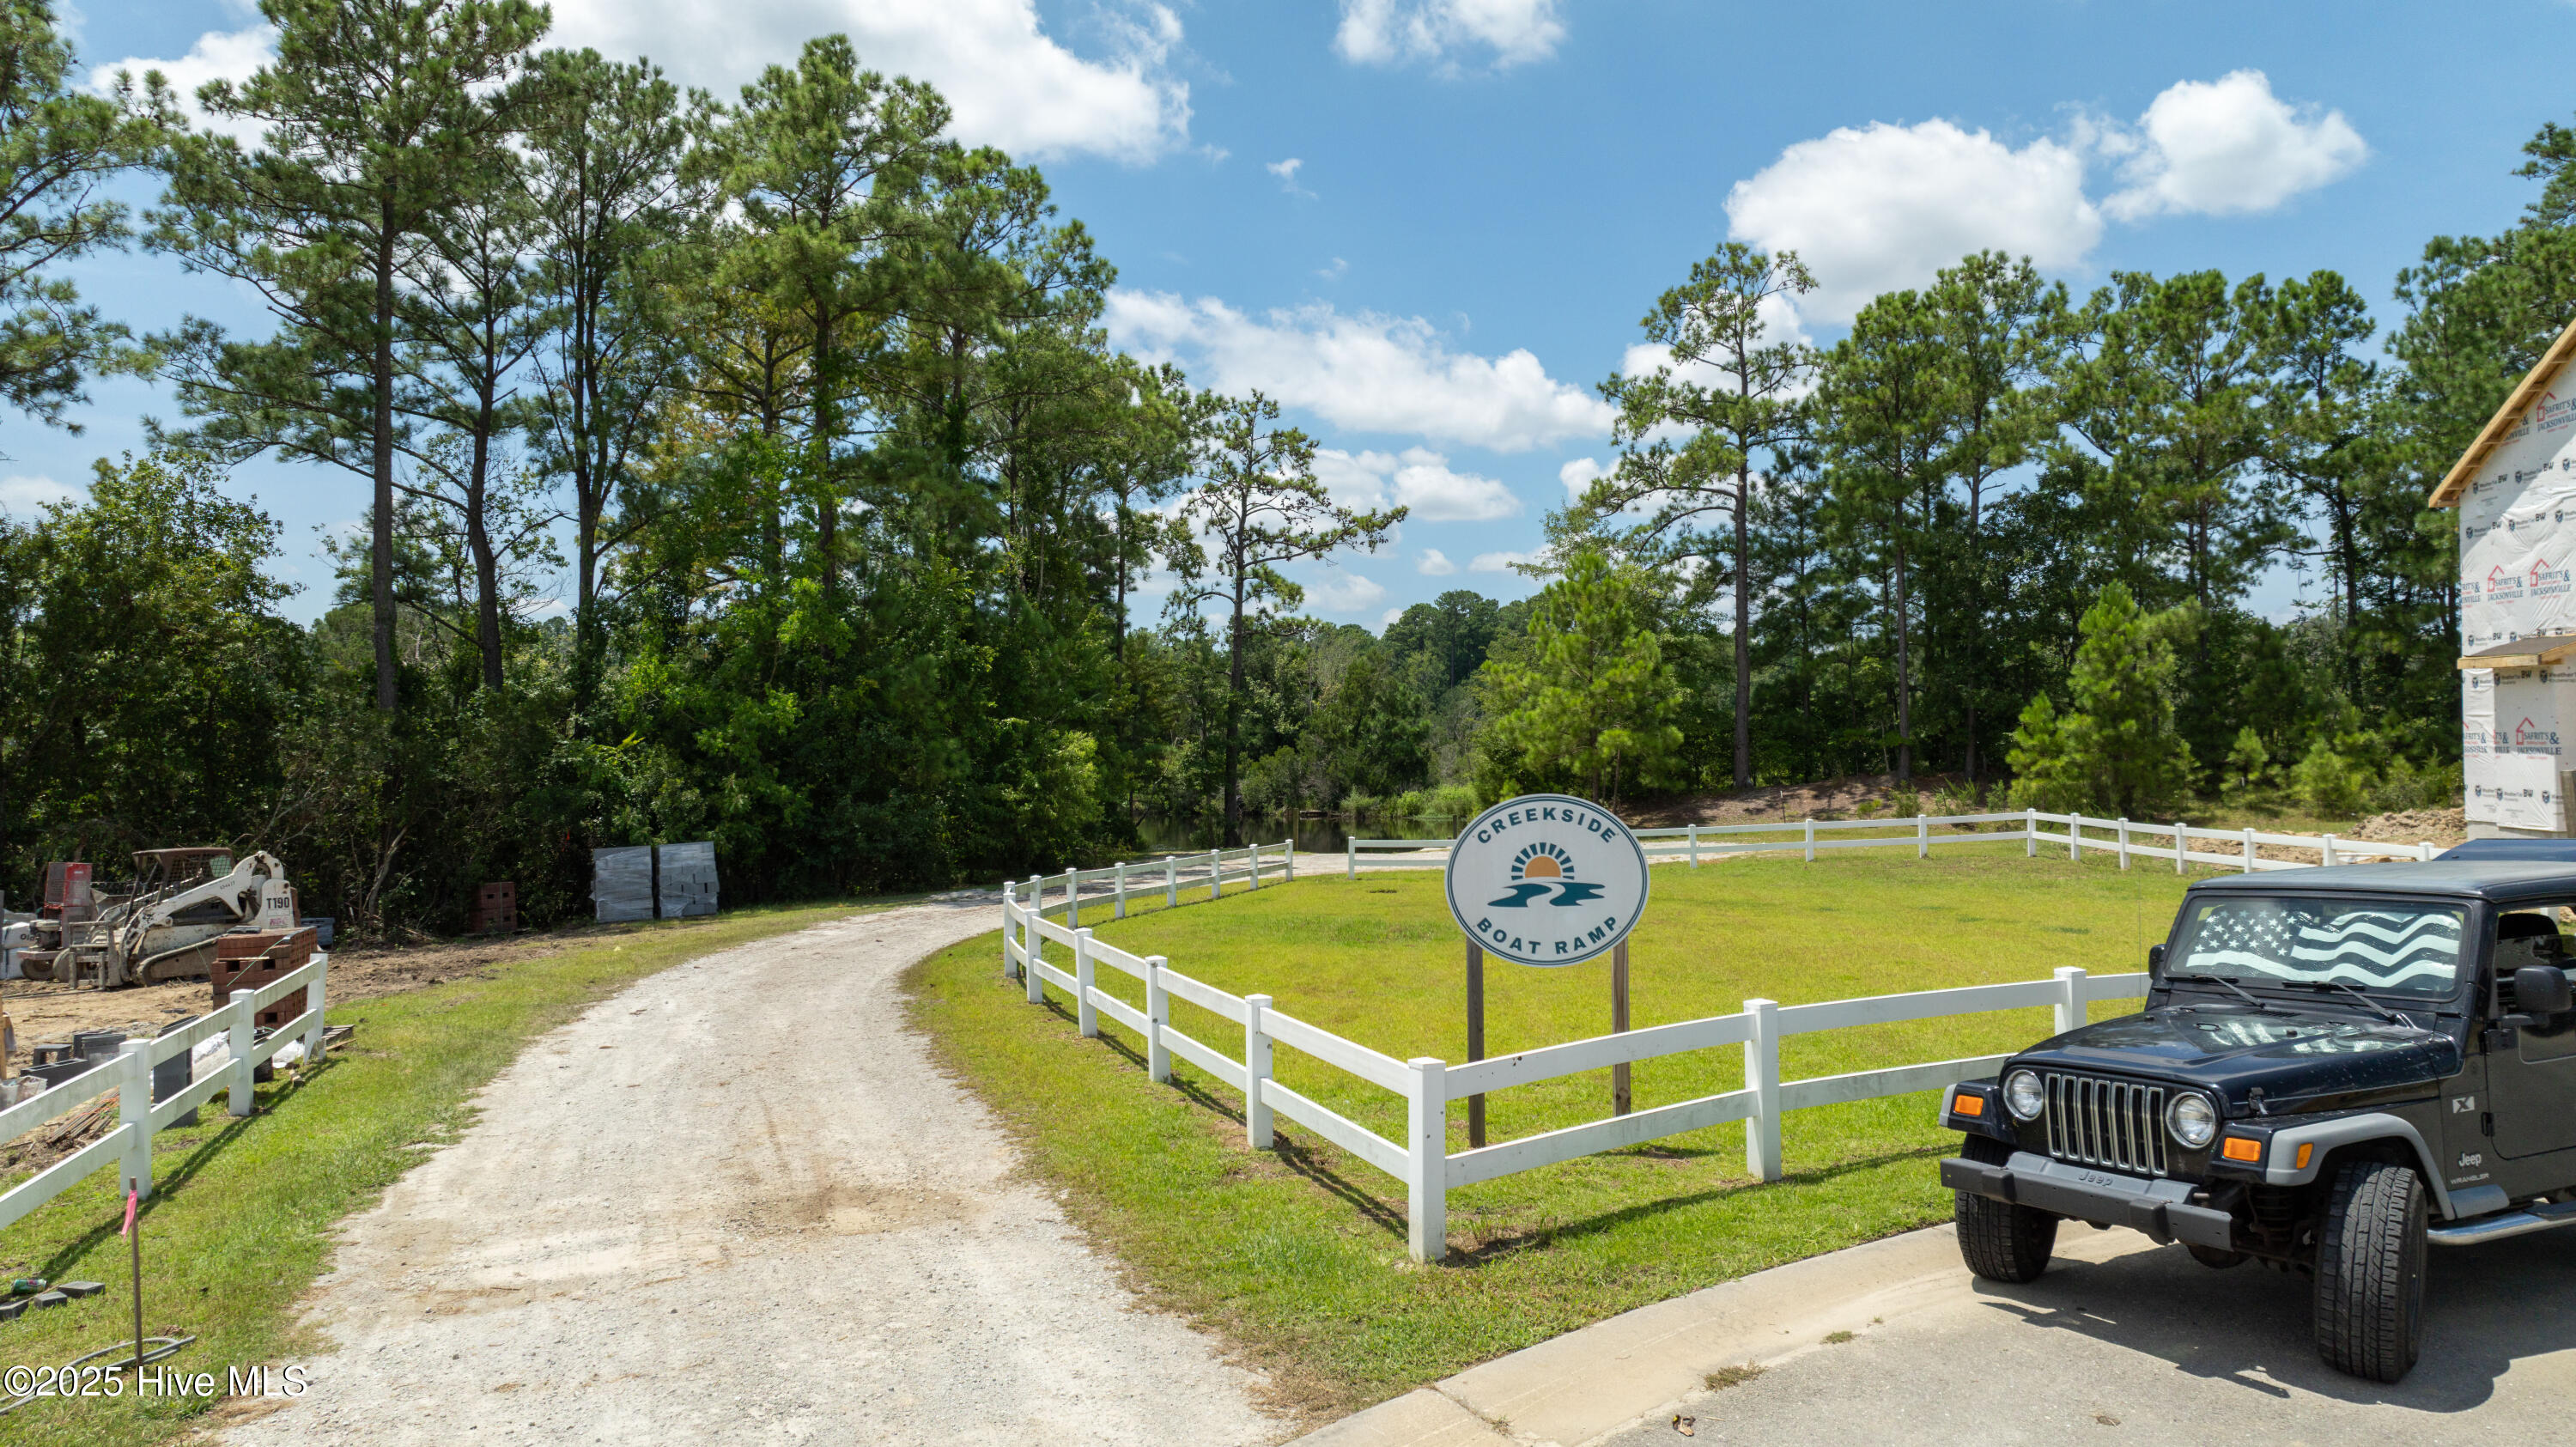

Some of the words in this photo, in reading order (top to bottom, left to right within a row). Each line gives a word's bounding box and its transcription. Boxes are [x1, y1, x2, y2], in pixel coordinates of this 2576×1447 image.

[2537, 412, 2576, 432] JACKSONVILL
[2516, 576, 2524, 588] &
[2563, 569, 2571, 582] &
[2549, 732, 2560, 745] &
[1477, 806, 1617, 844] CREEKSIDE
[266, 897, 290, 909] T190
[1476, 917, 1541, 954] BOAT
[1555, 916, 1618, 955] RAMP
[2458, 1152, 2482, 1167] Jeep
[2079, 1171, 2113, 1186] Jeep
[2451, 1172, 2489, 1184] WRANGLER
